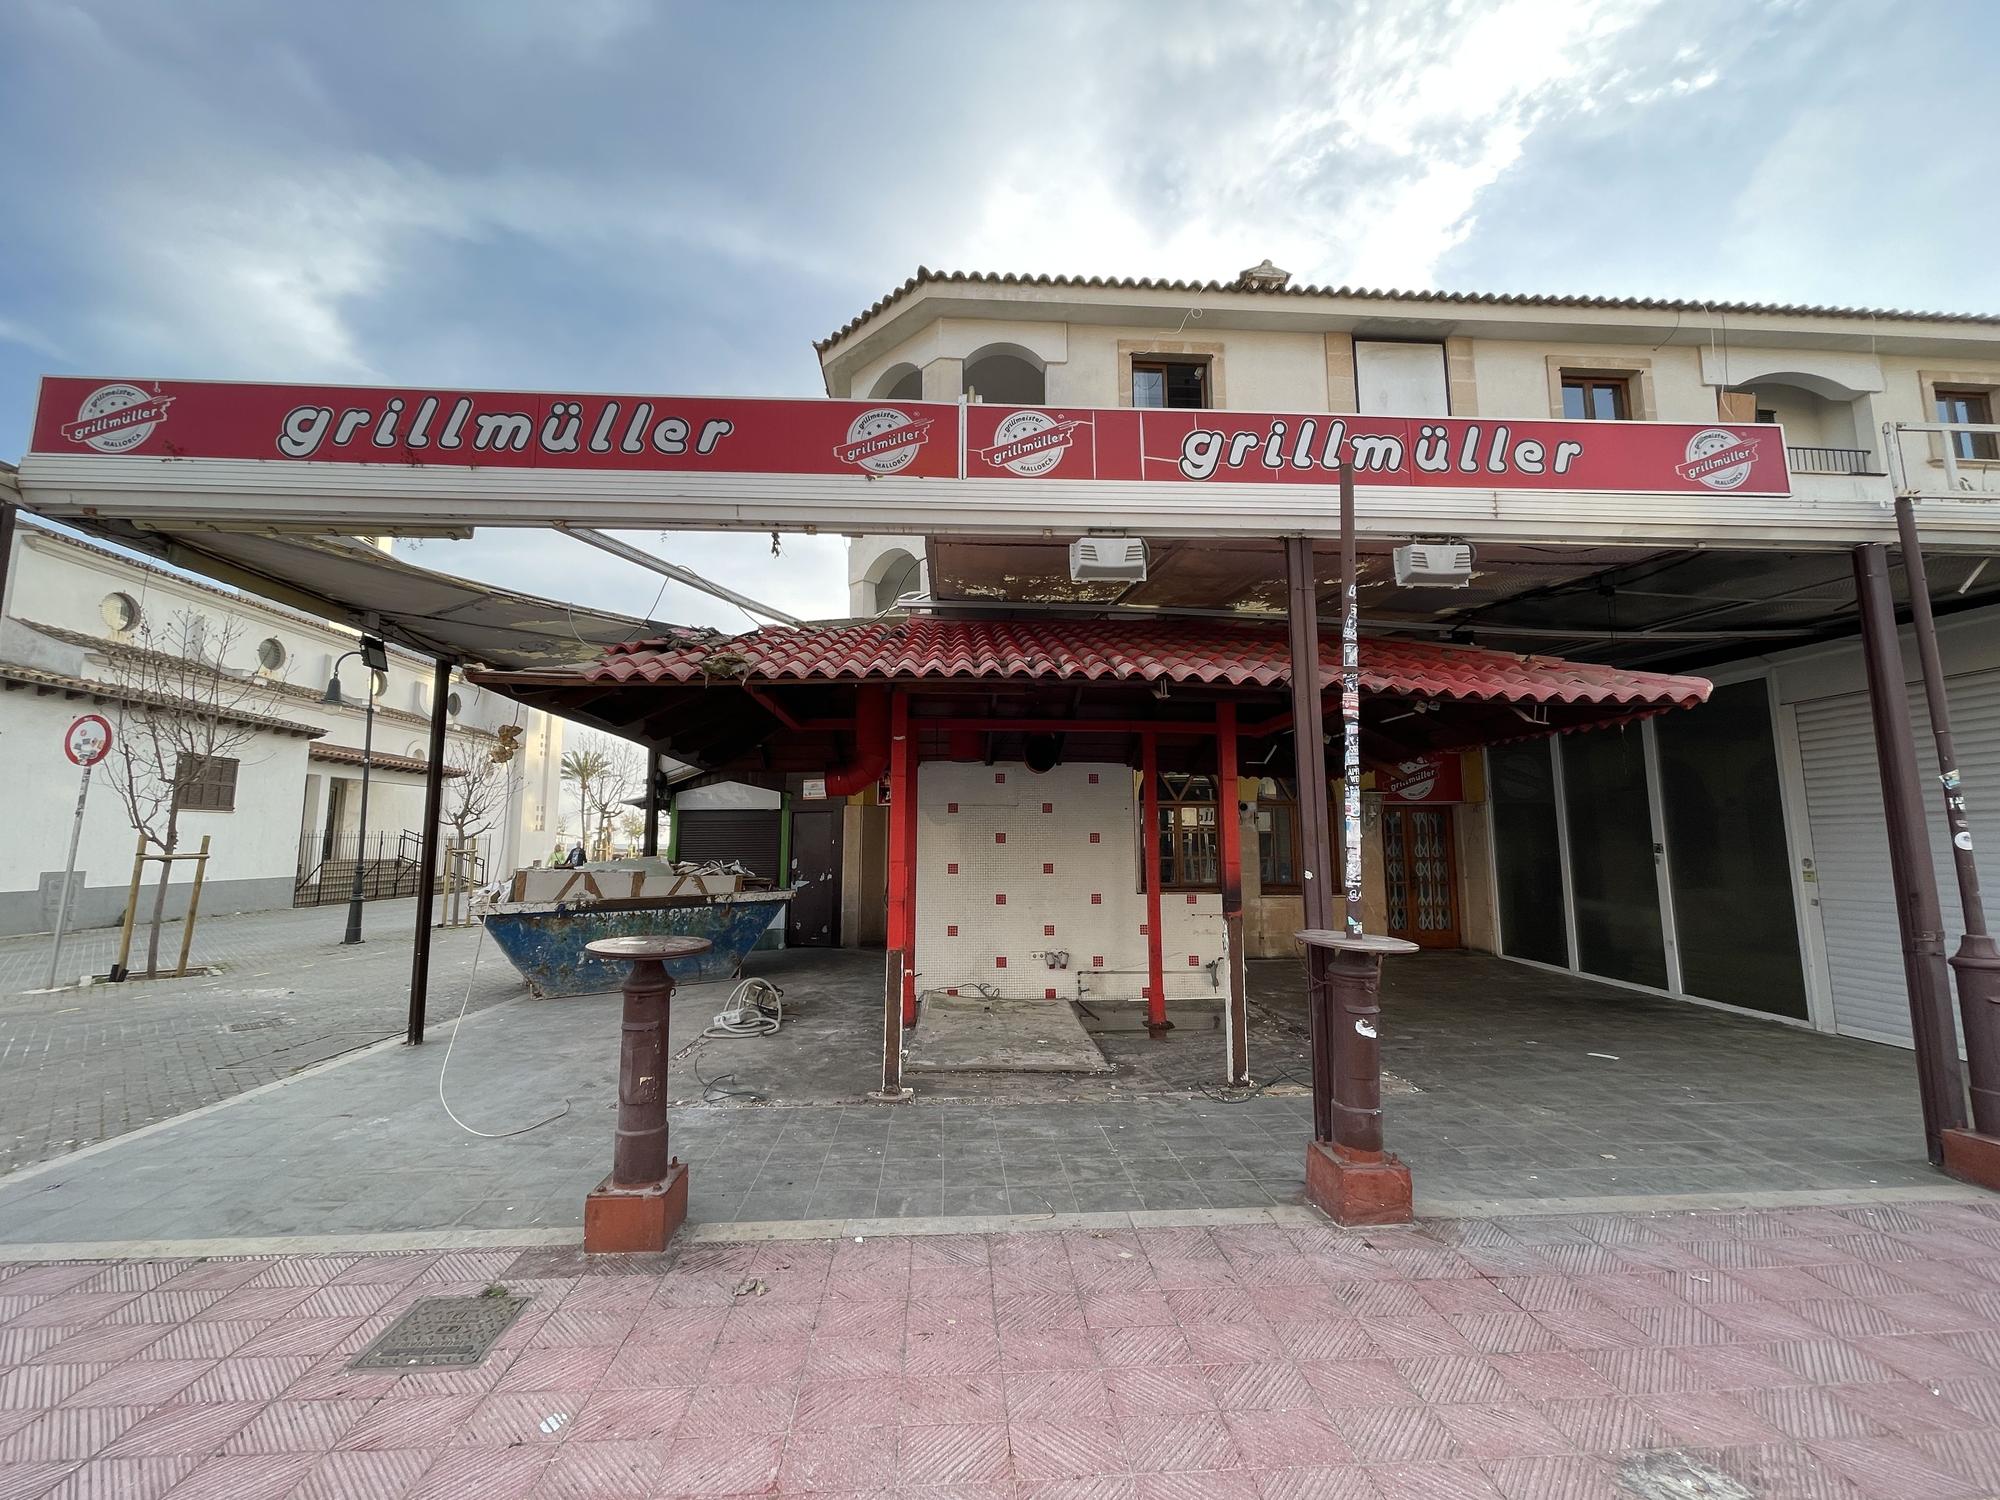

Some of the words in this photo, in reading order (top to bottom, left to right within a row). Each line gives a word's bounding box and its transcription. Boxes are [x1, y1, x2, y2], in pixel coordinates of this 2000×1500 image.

[74, 408, 158, 440] grillmüller
[276, 395, 735, 458] grillmüller
[858, 411, 899, 430] grillmeister
[1004, 415, 1044, 434] grillmeister
[103, 433, 142, 447] MALLORCA
[847, 430, 920, 461] grillmüller
[993, 433, 1065, 464] grillmüller
[1177, 418, 1584, 482] grillmüller
[874, 453, 909, 469] MALLORCA
[1019, 457, 1054, 472] MALLORCA
[1688, 449, 1750, 479] grillmüller
